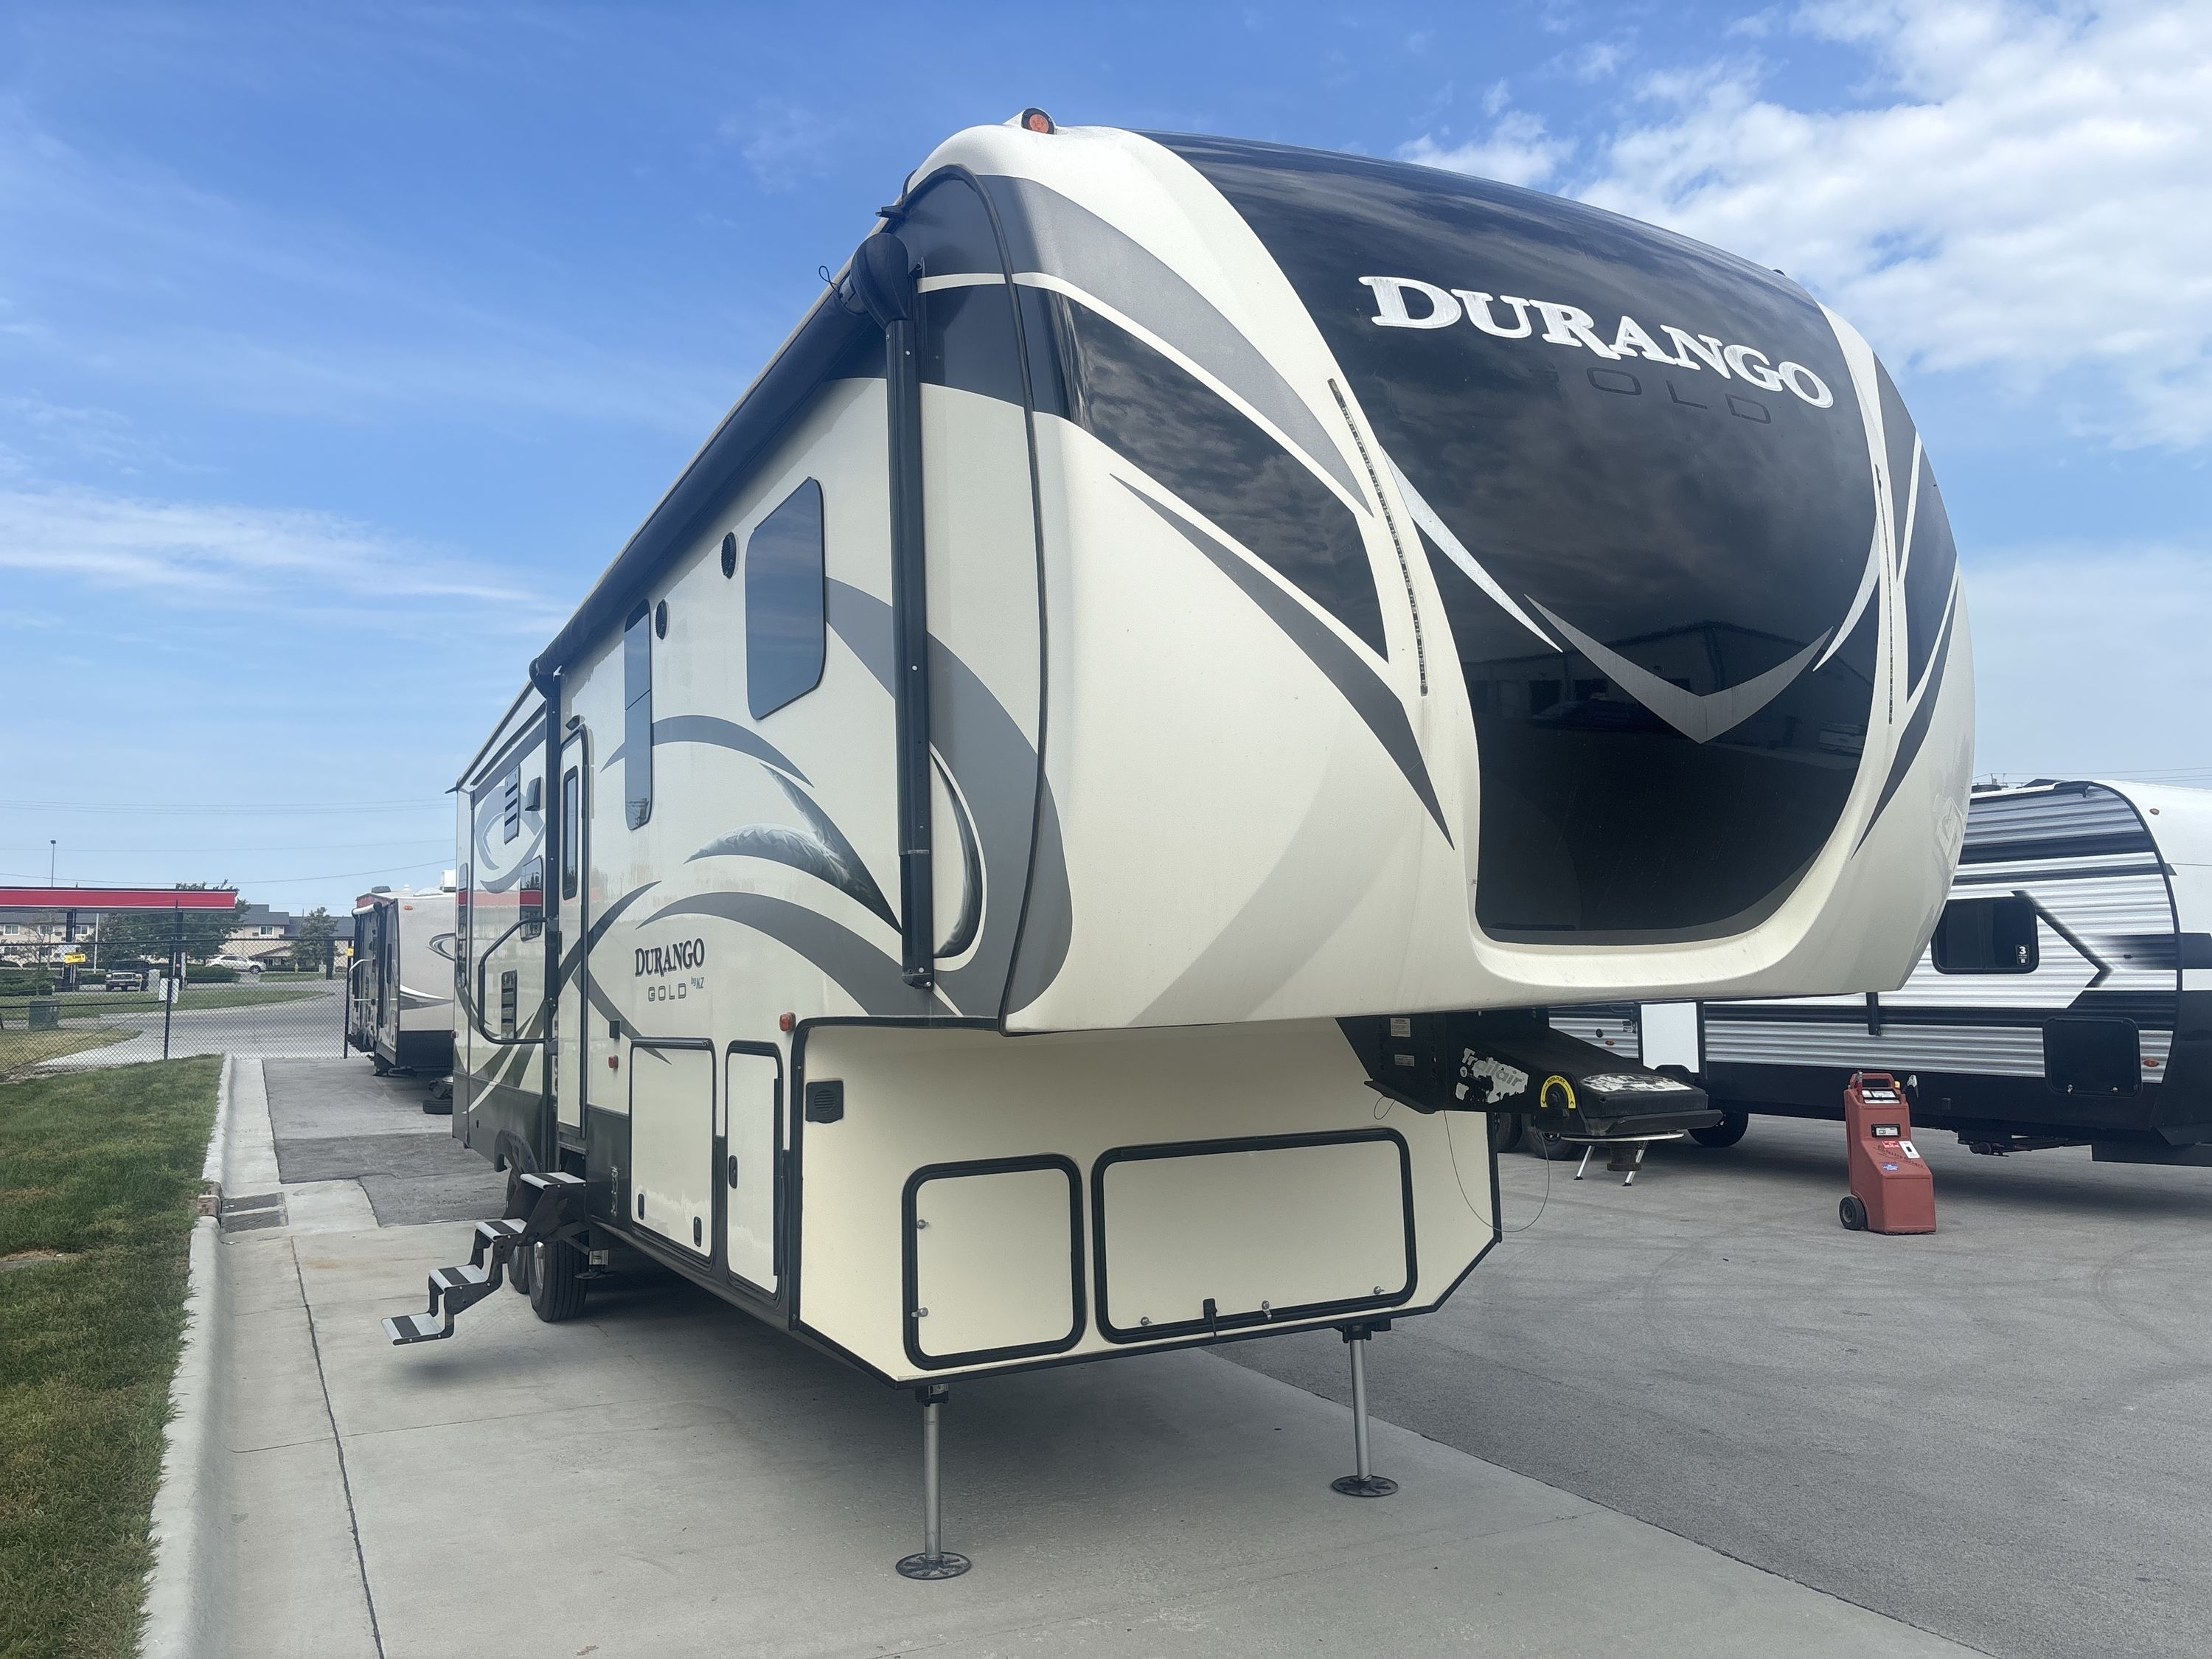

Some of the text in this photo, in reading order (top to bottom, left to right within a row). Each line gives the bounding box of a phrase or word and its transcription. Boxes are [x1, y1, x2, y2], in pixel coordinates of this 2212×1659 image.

[1358, 276, 1834, 408] DURANGO
[1531, 364, 1772, 425] OLD
[635, 938, 705, 977] DURANGO
[2019, 946, 2026, 954] 3
[648, 983, 686, 1001] GOLD
[1461, 1047, 1523, 1087] Trailair
